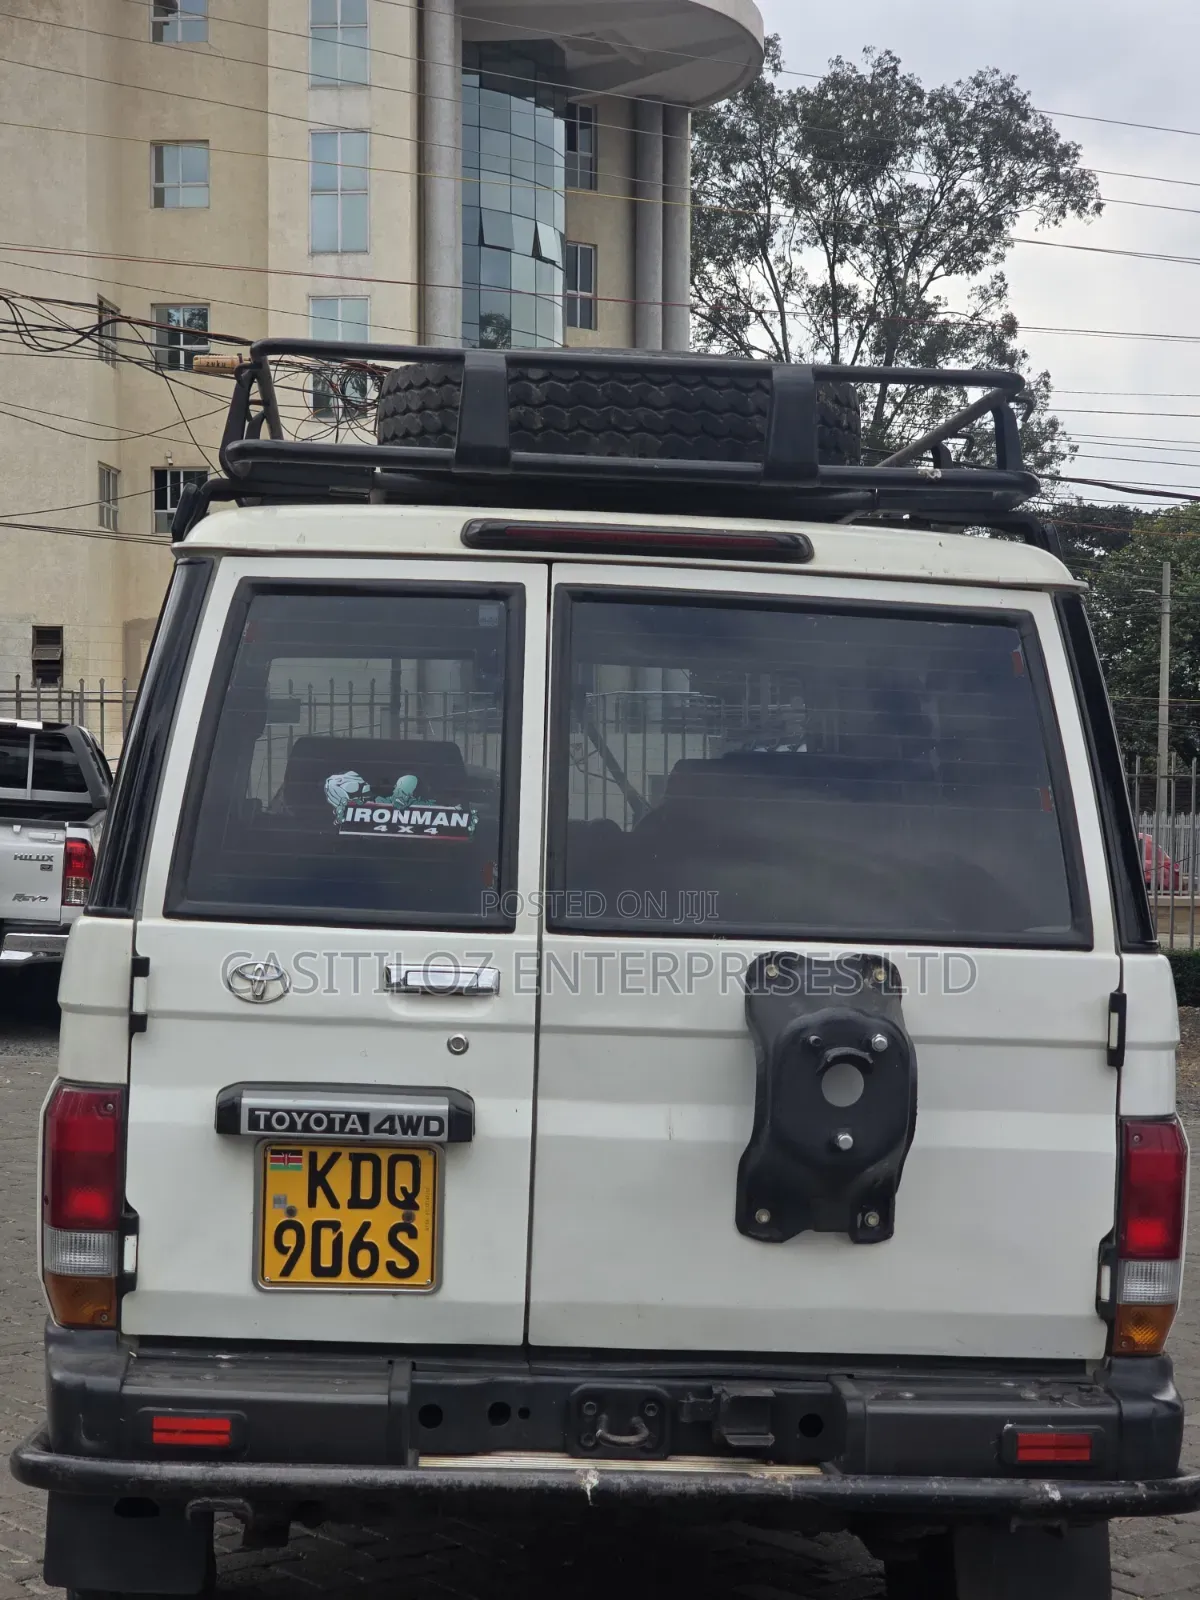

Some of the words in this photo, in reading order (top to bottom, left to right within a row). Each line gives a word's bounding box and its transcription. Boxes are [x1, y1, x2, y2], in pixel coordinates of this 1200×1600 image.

[345, 807, 469, 828] IRONMAN
[13, 852, 54, 862] HILUX
[254, 1110, 364, 1133] TOYOTA
[373, 1114, 446, 1137] 4WD
[307, 1151, 422, 1211] KDQ
[273, 1219, 421, 1279] 906S
